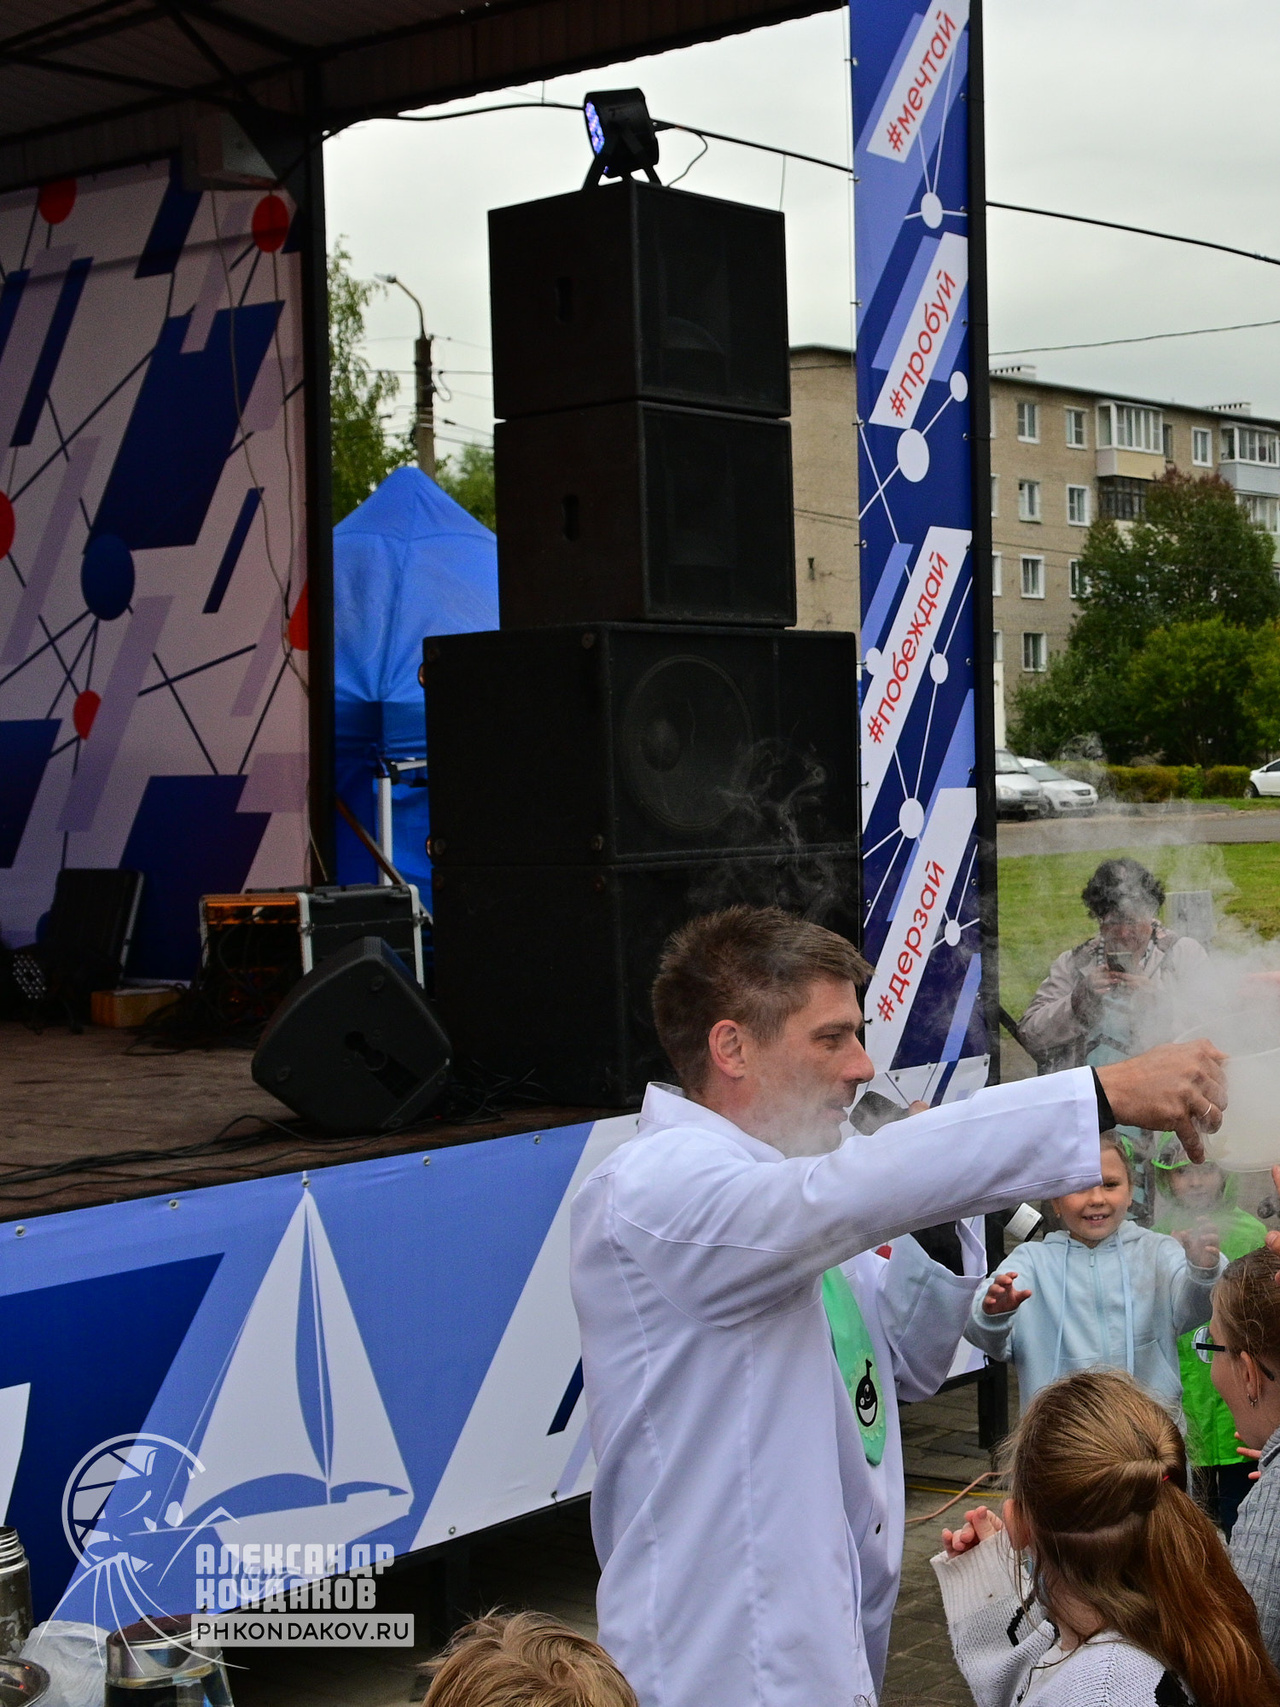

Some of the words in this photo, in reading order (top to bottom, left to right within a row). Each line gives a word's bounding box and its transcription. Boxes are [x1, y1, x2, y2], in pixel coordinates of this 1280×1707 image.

[886, 10, 957, 152] #мечтай
[889, 269, 956, 418] #пробуй
[867, 551, 949, 744] #побеждай
[876, 860, 945, 1022] #дерзай
